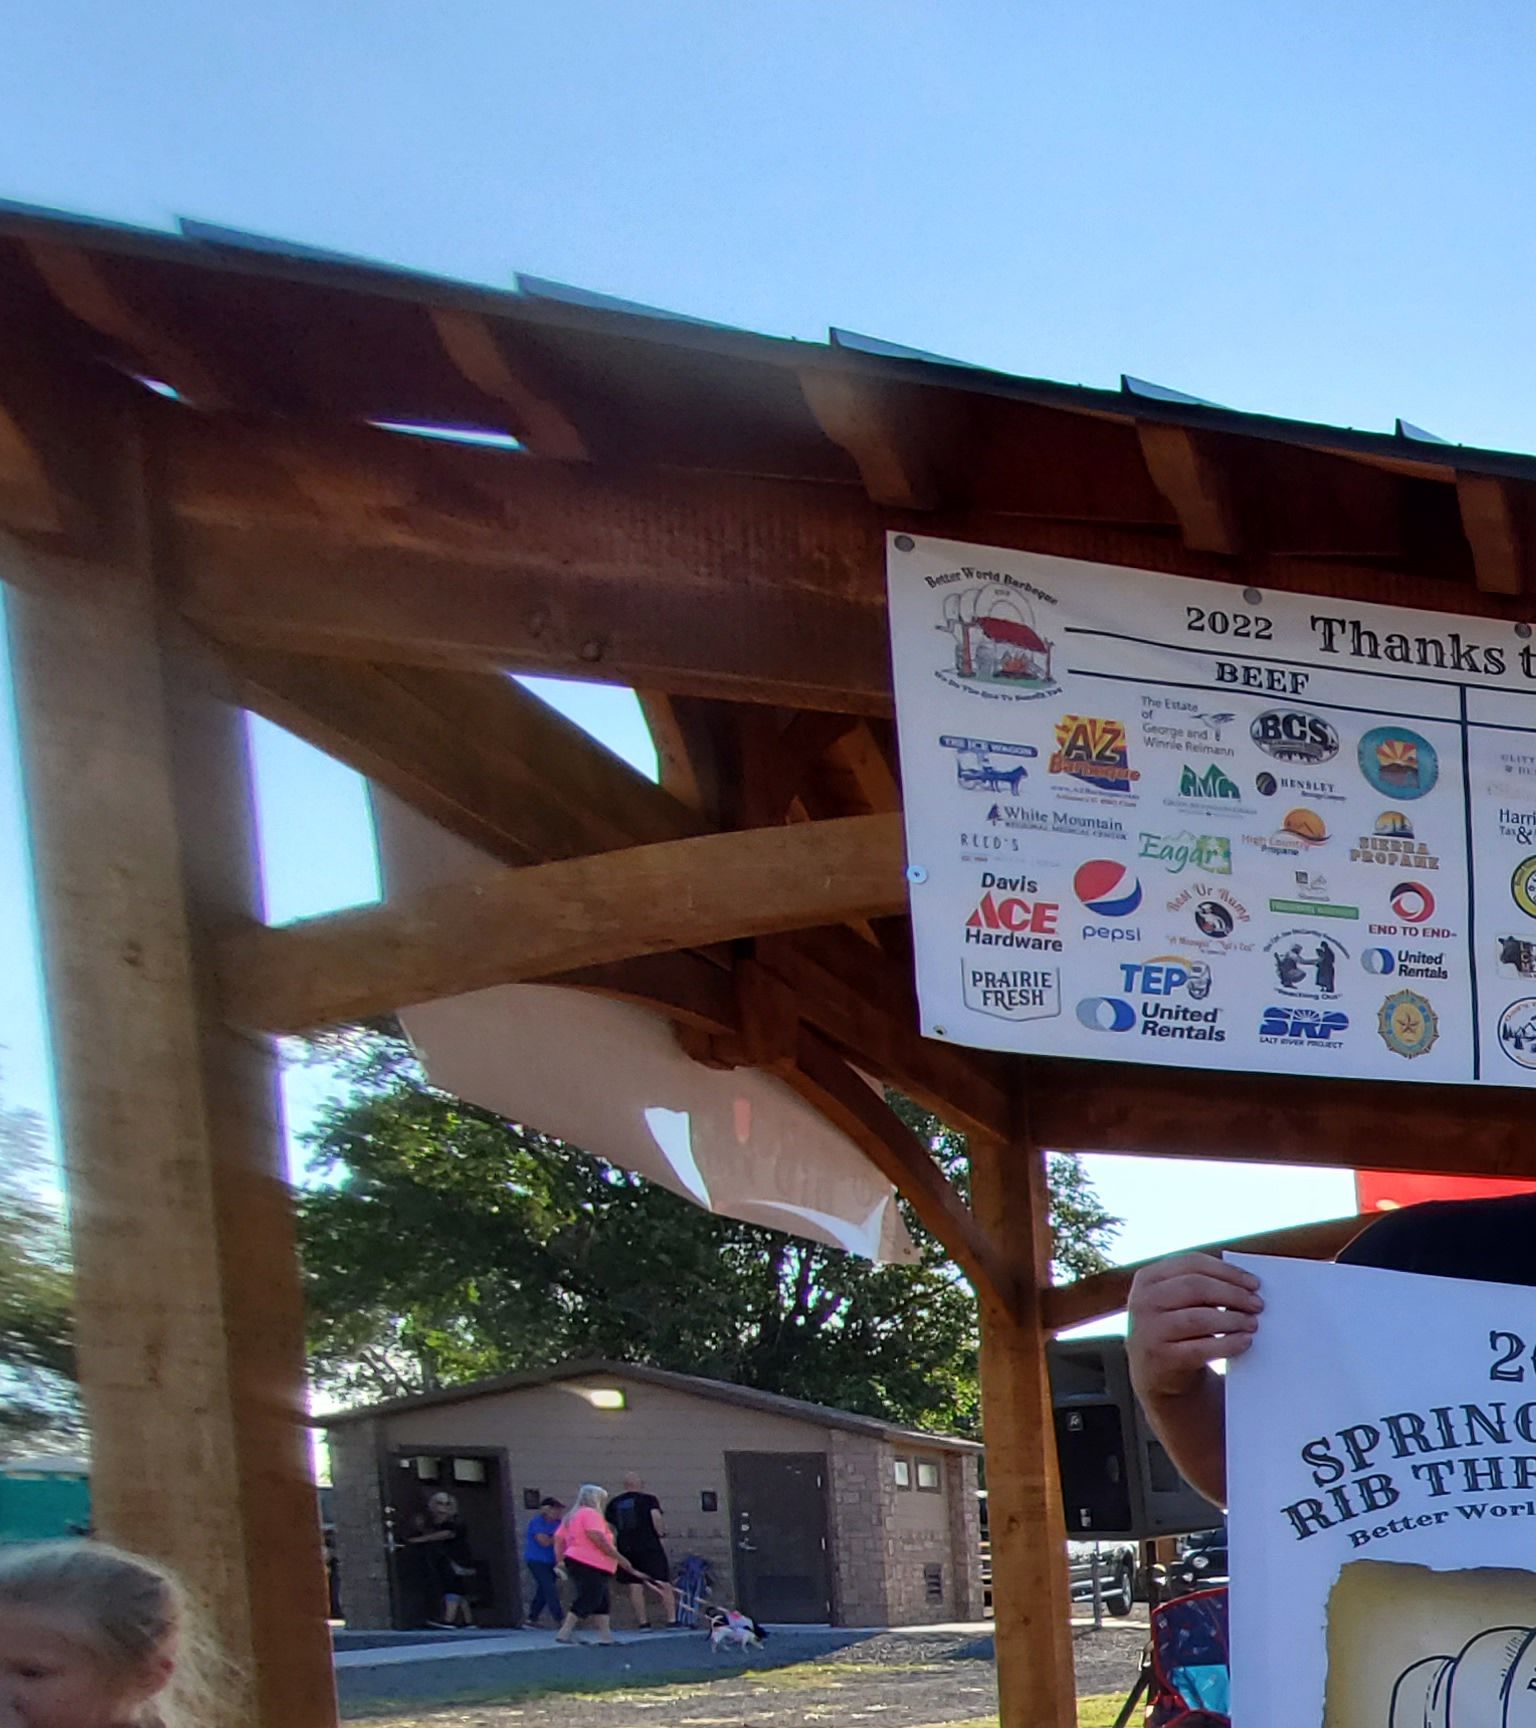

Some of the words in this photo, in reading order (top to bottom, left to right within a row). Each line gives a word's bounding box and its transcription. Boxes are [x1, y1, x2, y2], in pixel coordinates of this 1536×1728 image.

[925, 571, 961, 589] Better
[961, 567, 1001, 583] World
[1003, 574, 1058, 605] Barbeque
[1187, 606, 1273, 640] 2022
[1311, 615, 1506, 676] Thanks
[1215, 661, 1310, 695] BEEF
[1141, 696, 1162, 709] The
[1164, 698, 1199, 713] Estate
[1141, 709, 1153, 719] of
[1142, 723, 1184, 739] George
[1186, 726, 1208, 740] and
[1259, 712, 1331, 747] BCS
[1063, 722, 1123, 763] AZ
[1143, 737, 1183, 752] Winnie
[1048, 753, 1141, 783] Barbeque
[1281, 778, 1336, 793] HENSLEY
[1004, 805, 1049, 823] White
[1052, 811, 1124, 831] Mountain
[1241, 833, 1267, 848] High
[1359, 836, 1430, 855] SIERRA
[1500, 826, 1517, 836] Tax
[1516, 826, 1533, 846] &
[1139, 832, 1224, 874] Eagar
[1260, 845, 1299, 856] Propane
[1350, 849, 1440, 870] PROPANE
[981, 872, 1038, 894] Davis
[965, 889, 1060, 935] ACE
[965, 928, 1063, 953] Hardware
[1082, 925, 1141, 943] pepsi
[1368, 924, 1398, 936] END
[1400, 926, 1419, 937] TO
[1421, 927, 1450, 939] END
[1397, 949, 1443, 965] United
[971, 970, 1053, 989] PRAIRIE
[1119, 963, 1188, 996] TEP
[1397, 963, 1449, 980] Rentals
[983, 989, 1045, 1012] FRESH
[1141, 1001, 1218, 1023] United
[1259, 1006, 1350, 1040] SRP
[1141, 1021, 1227, 1043] Rentals
[1259, 1037, 1277, 1046] SALT
[1280, 1038, 1304, 1047] RIVER
[1306, 1039, 1344, 1050] PROJECT
[1279, 1470, 1402, 1542] RIB
[1348, 1507, 1450, 1550] Better
